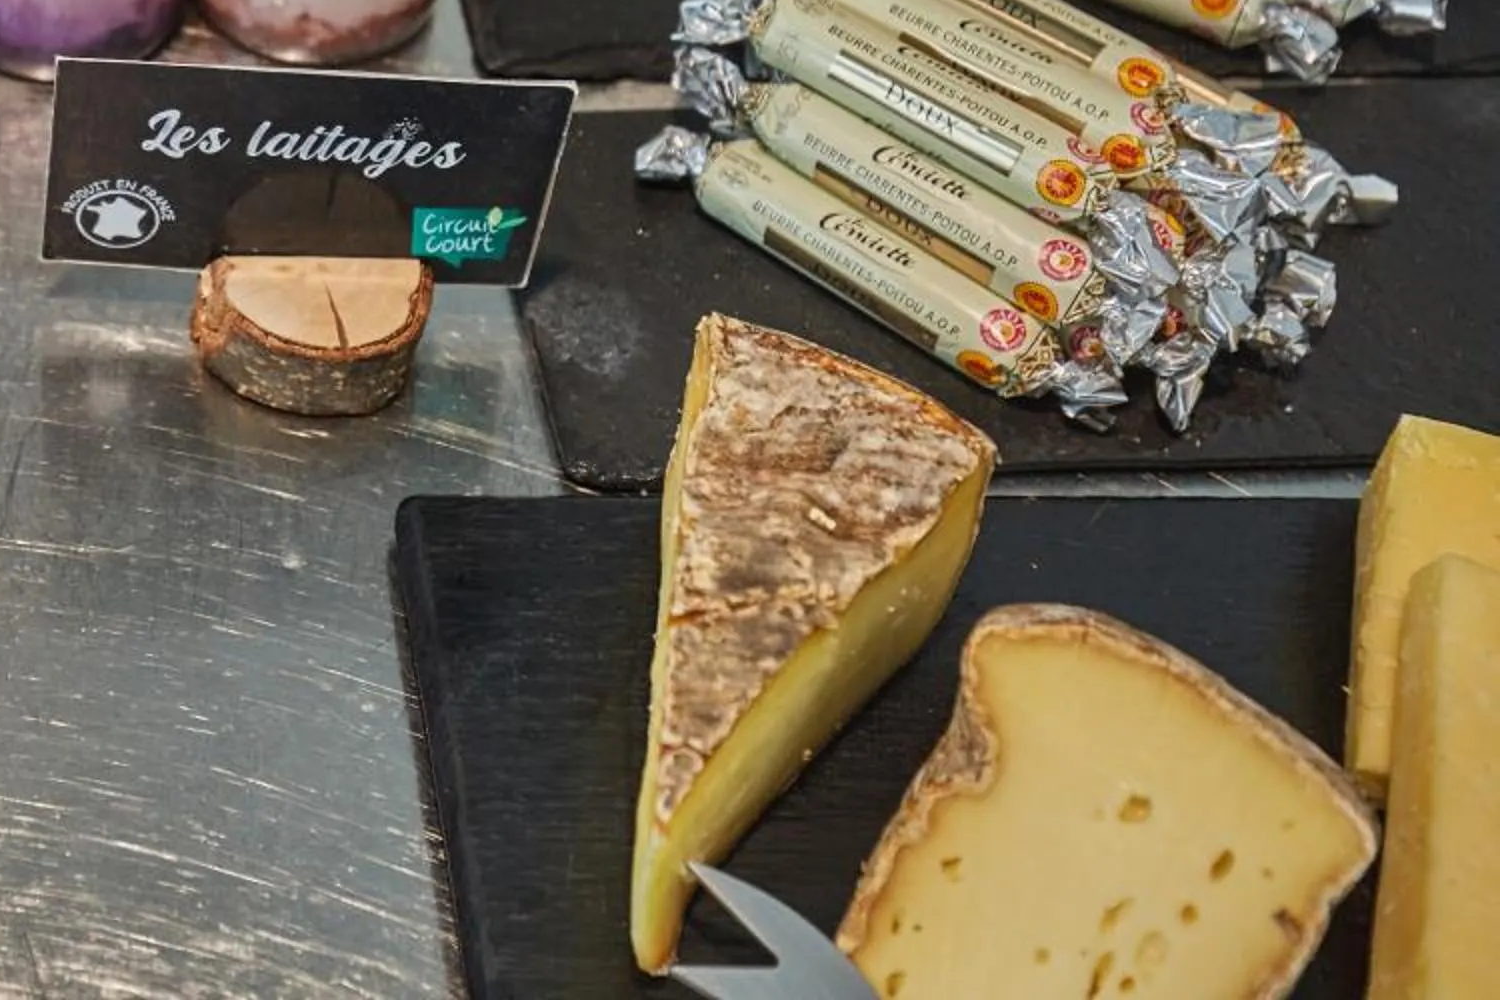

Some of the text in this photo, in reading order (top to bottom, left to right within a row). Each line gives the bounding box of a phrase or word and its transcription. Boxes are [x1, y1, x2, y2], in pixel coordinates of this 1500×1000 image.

[828, 23, 877, 57] BEURRE
[881, 51, 1009, 130] CHARENTES-POITOU
[889, 4, 941, 41] BEURRE
[942, 28, 1073, 103] CHARENTES-POITOU
[140, 108, 467, 179] Les laitages
[804, 132, 853, 171] BEURRE
[855, 164, 981, 246] CHARENTES-POITOU
[61, 179, 176, 221] PRODUIT EN FRANCE
[751, 198, 802, 236] BEURRE
[802, 231, 925, 315] CHARENTES-POITOU
